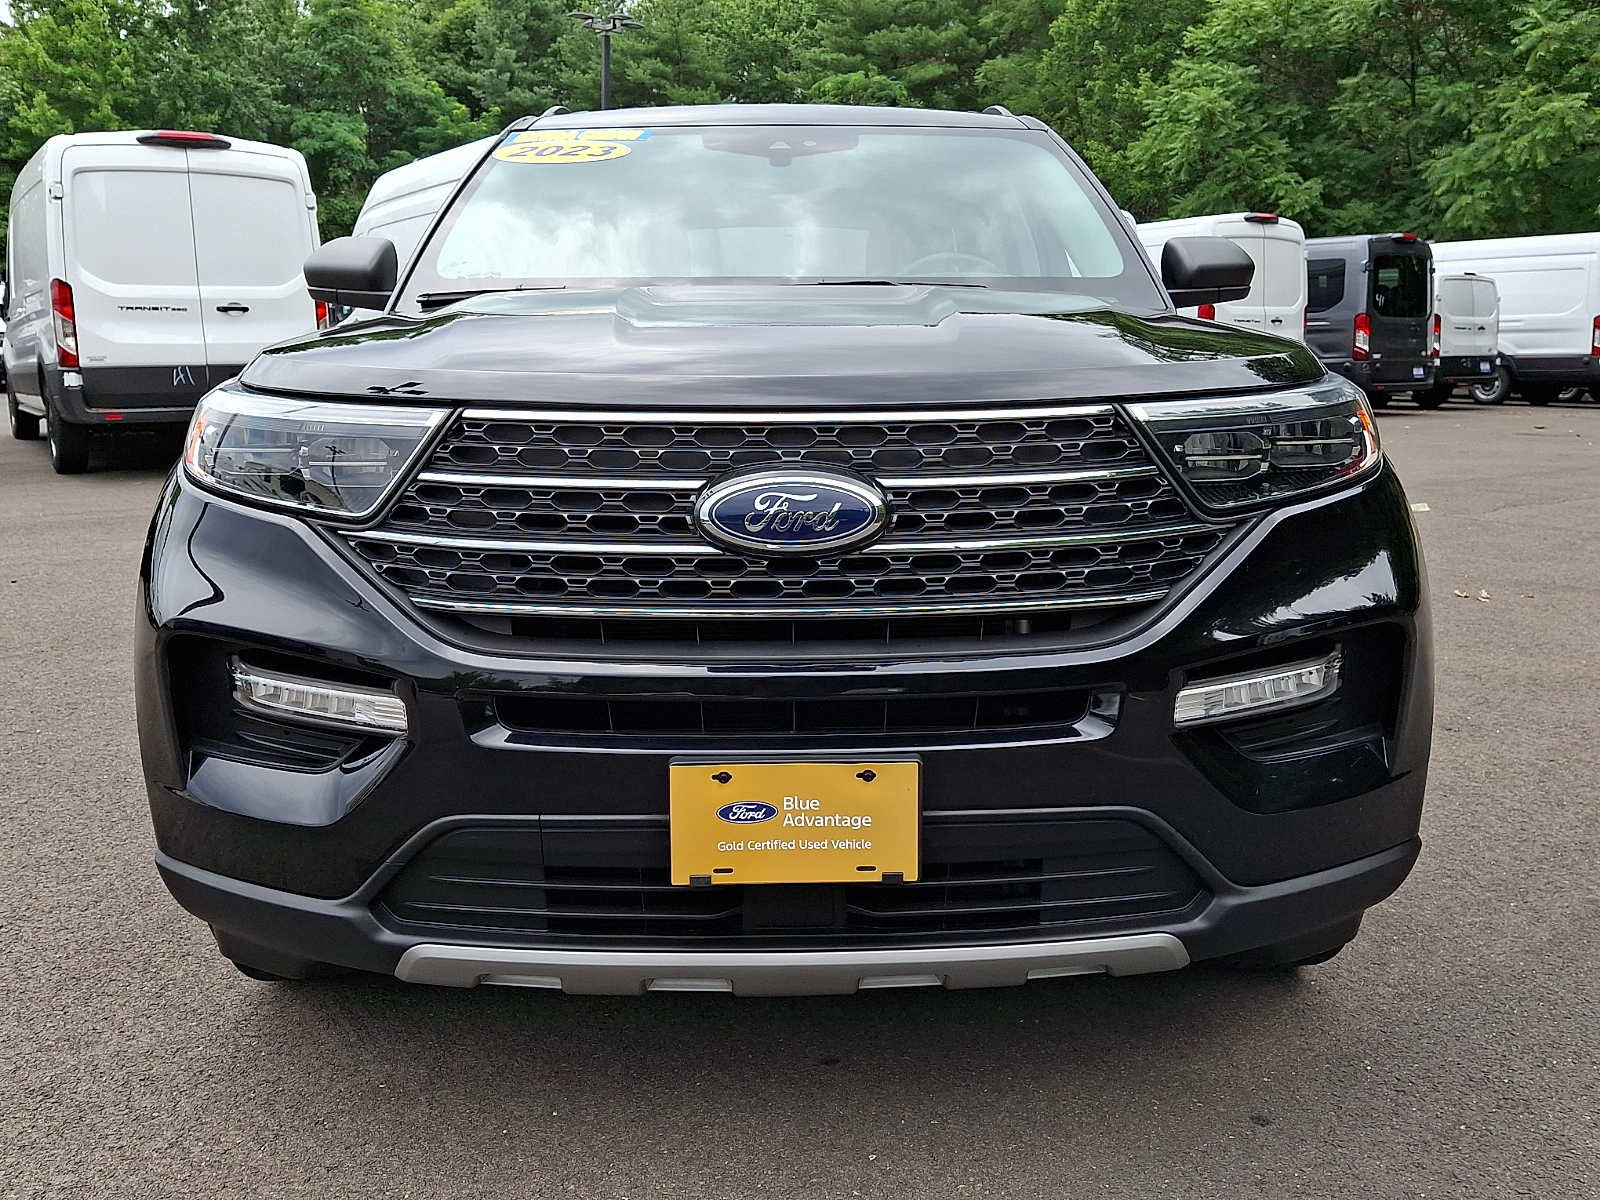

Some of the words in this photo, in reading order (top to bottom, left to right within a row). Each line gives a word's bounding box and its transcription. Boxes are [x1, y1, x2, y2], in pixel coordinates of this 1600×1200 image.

[507, 145, 617, 158] 2023
[744, 492, 842, 533] Ford
[783, 796, 820, 811] Blue
[728, 804, 767, 820] Ford
[783, 812, 872, 829] Advantage
[717, 840, 744, 851] Gold
[747, 839, 796, 850] Certified
[799, 839, 828, 850] Used
[831, 838, 872, 849] Vehicle
